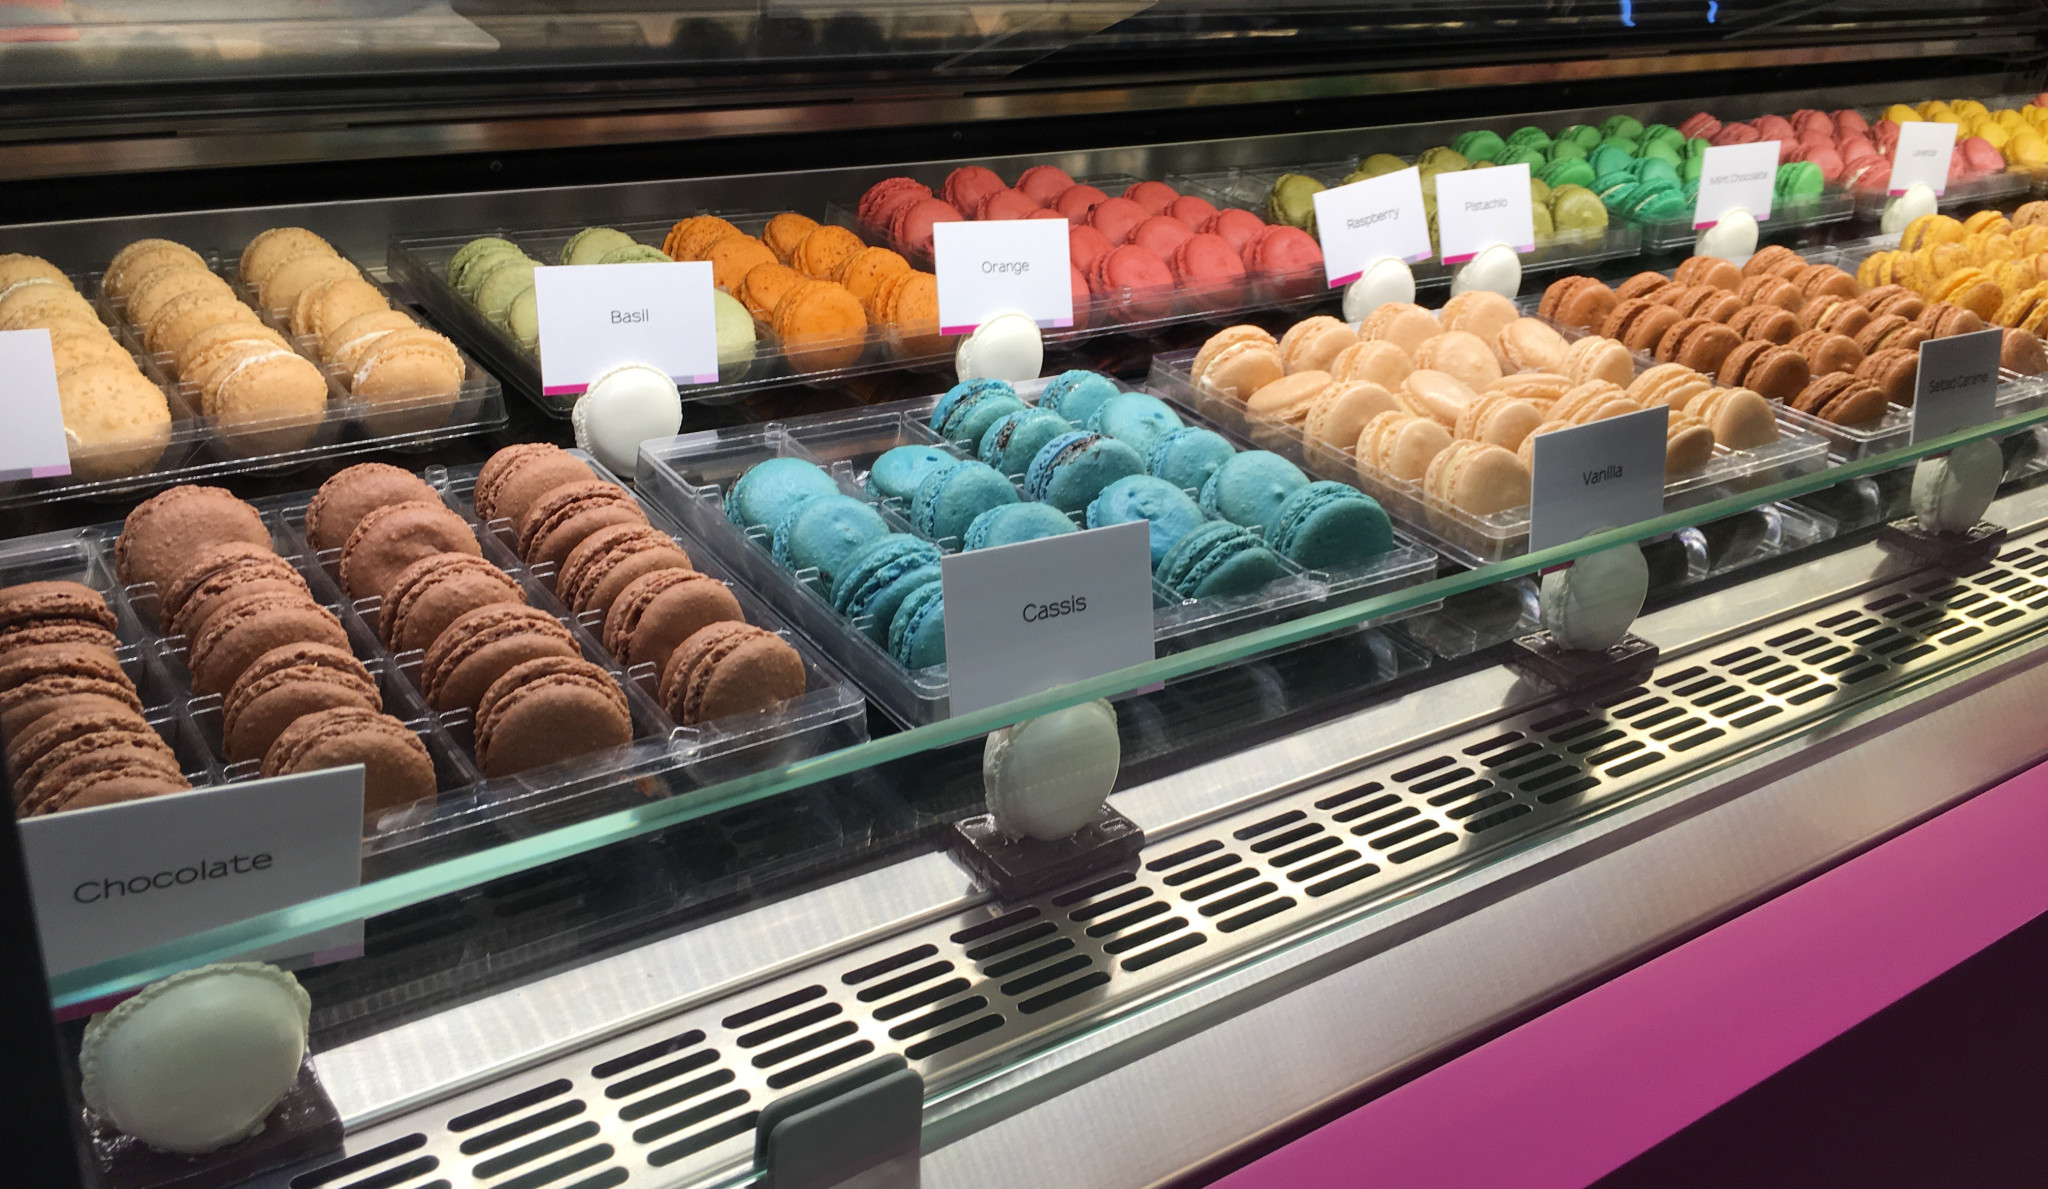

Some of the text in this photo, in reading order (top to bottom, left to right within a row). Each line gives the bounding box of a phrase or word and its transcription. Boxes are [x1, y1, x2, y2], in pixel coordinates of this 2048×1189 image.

[1464, 197, 1508, 212] Pistachio
[1346, 208, 1400, 229] Raspberry
[981, 260, 1030, 276] Orange
[610, 309, 650, 324] Basil
[1582, 464, 1623, 486] Vanilla
[1022, 594, 1087, 623] Cassis
[73, 851, 273, 904] Chocolate
